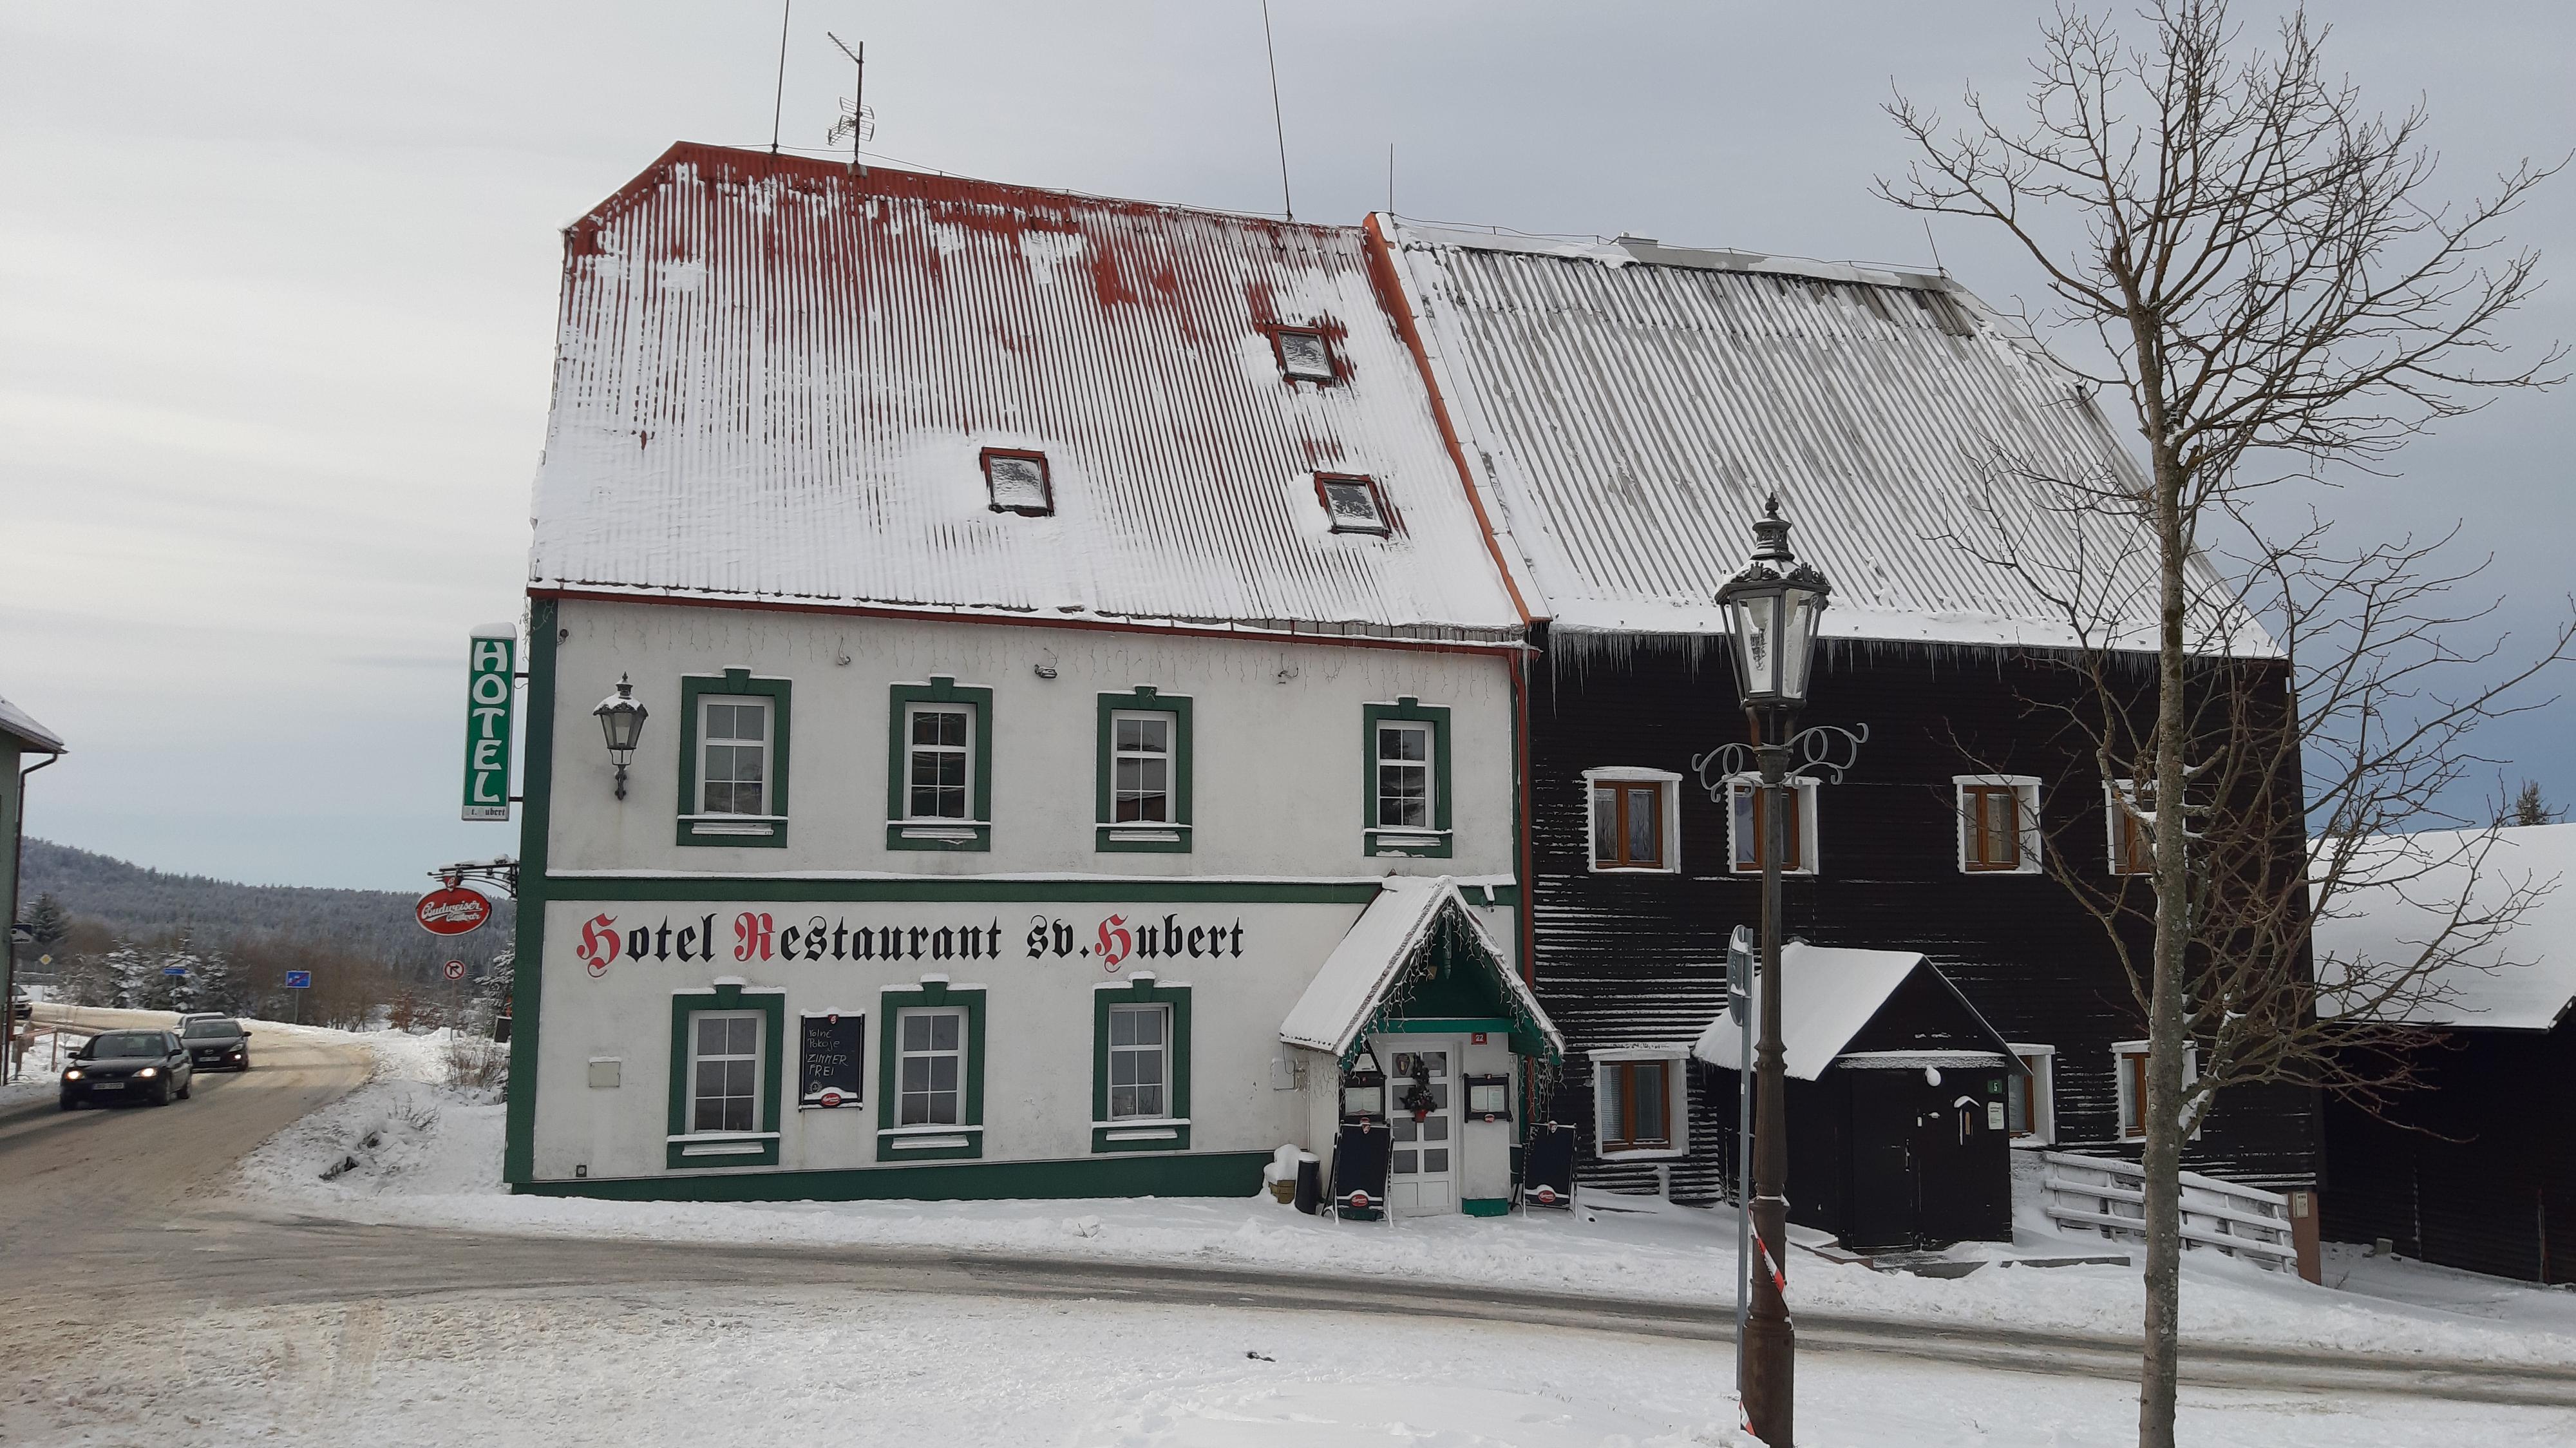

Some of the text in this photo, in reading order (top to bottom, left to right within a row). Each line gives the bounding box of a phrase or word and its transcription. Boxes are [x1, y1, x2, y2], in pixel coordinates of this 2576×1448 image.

[472, 642, 507, 803] HOTEL
[479, 808, 506, 816] ubert
[421, 900, 482, 920] Budweiser
[576, 913, 717, 977] Hotel
[734, 912, 1001, 962] Restaurant
[807, 1038, 840, 1051] Pokoje
[807, 1054, 848, 1066] ZIMMER
[809, 1064, 834, 1077] FREI
